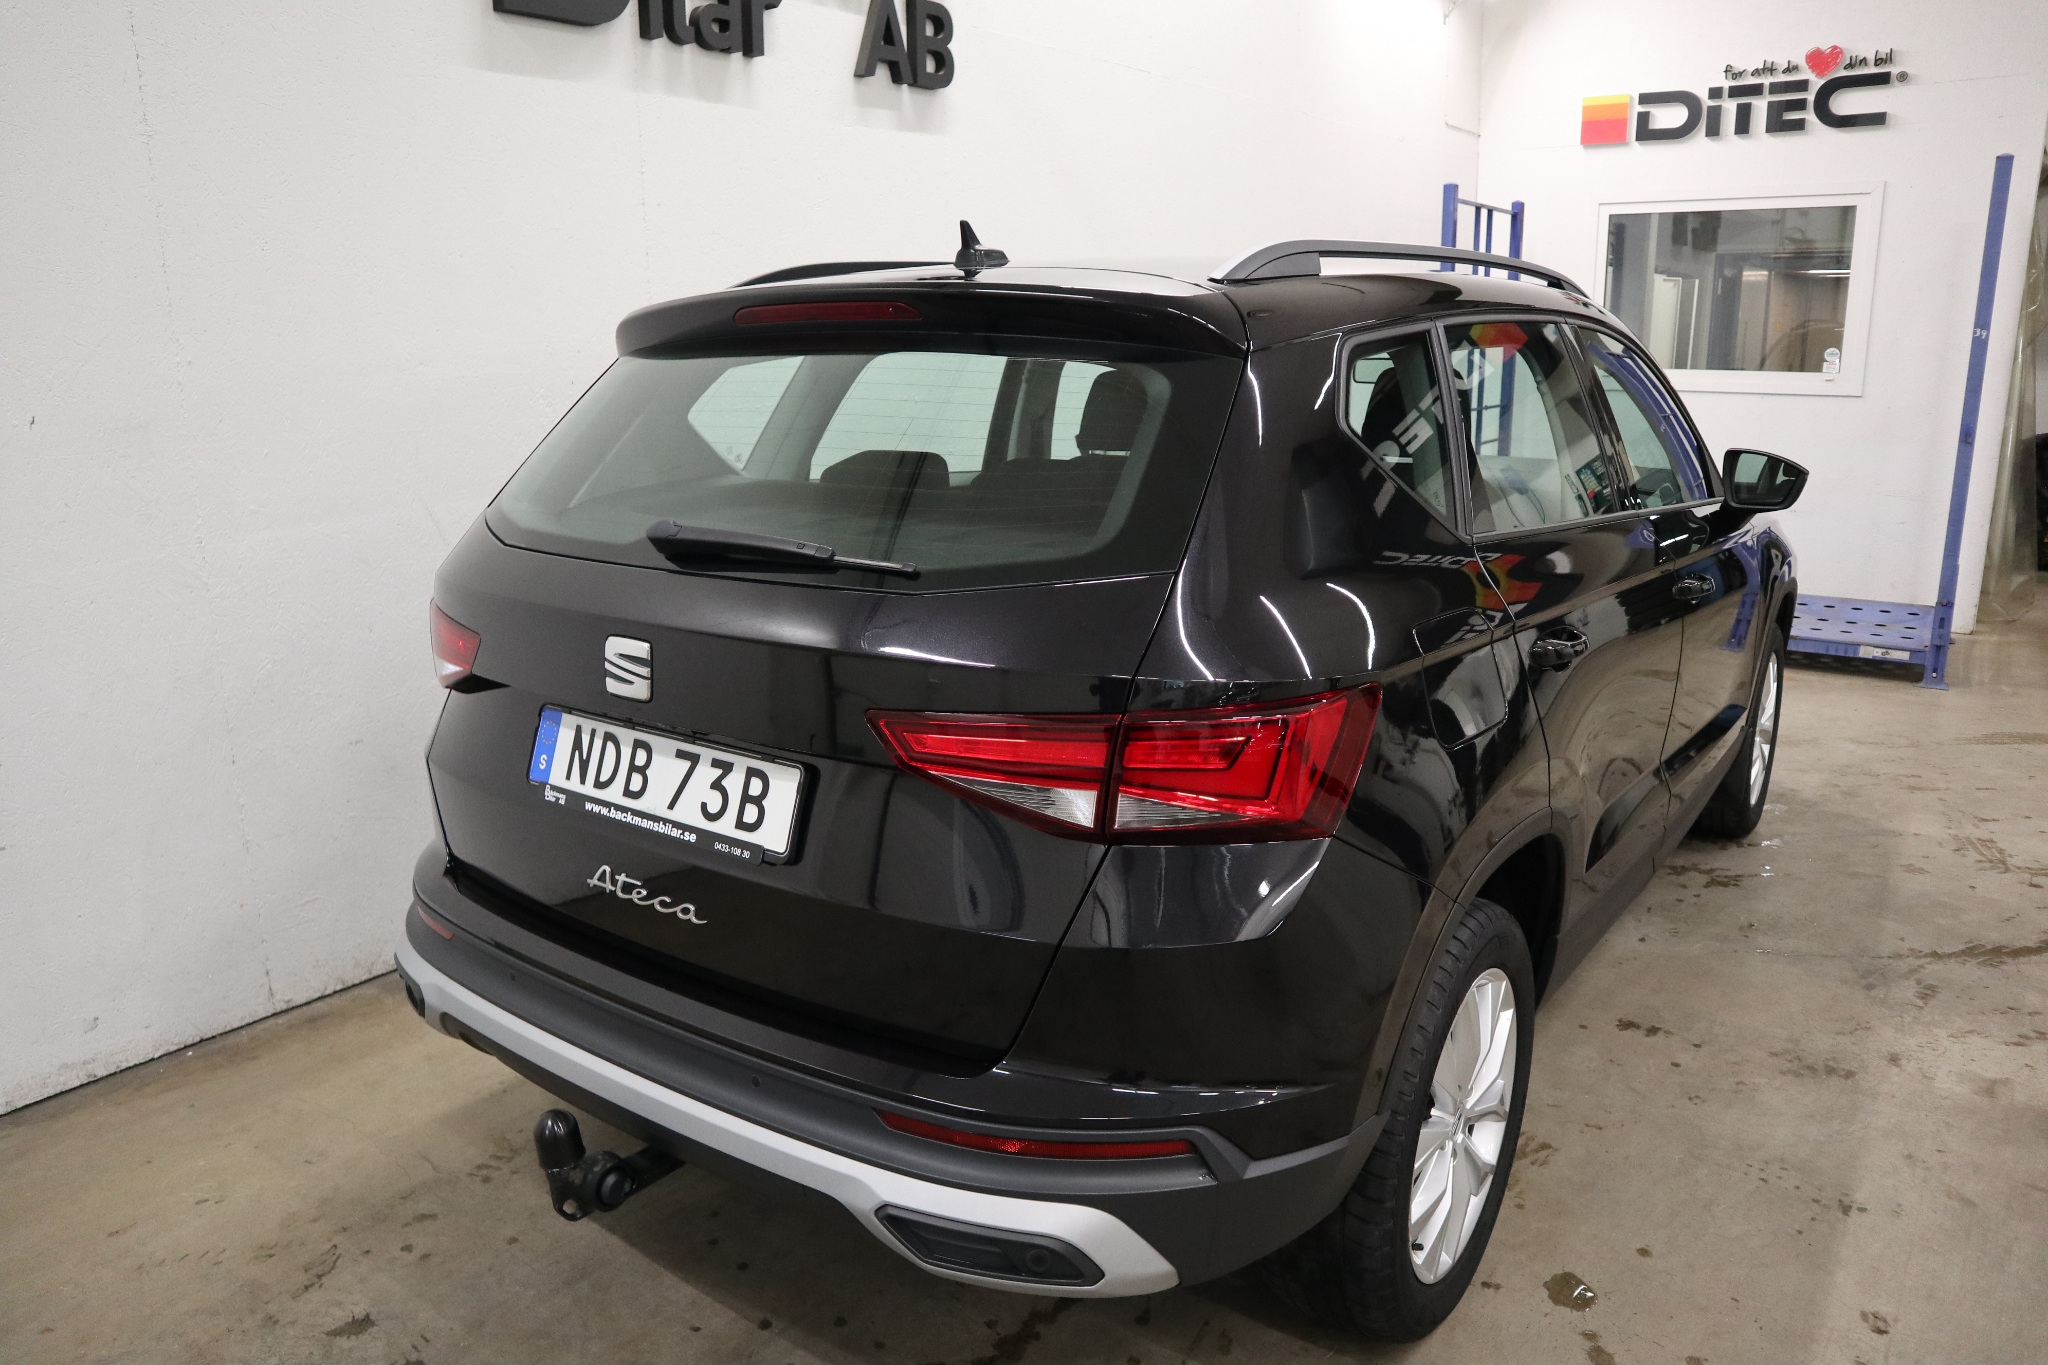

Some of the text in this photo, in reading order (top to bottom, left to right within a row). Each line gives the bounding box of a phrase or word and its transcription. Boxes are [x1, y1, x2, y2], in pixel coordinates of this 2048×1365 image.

[493, 0, 955, 90] ilar AB
[1751, 59, 1778, 77] att
[1782, 60, 1800, 75] du
[1843, 55, 1868, 71] din
[1873, 48, 1893, 67] bil
[538, 754, 548, 770] S
[565, 724, 770, 833] NDB 73B
[585, 801, 697, 843] www.backmansbilar.se
[742, 850, 750, 859] 30
[587, 864, 708, 925] Ateca
